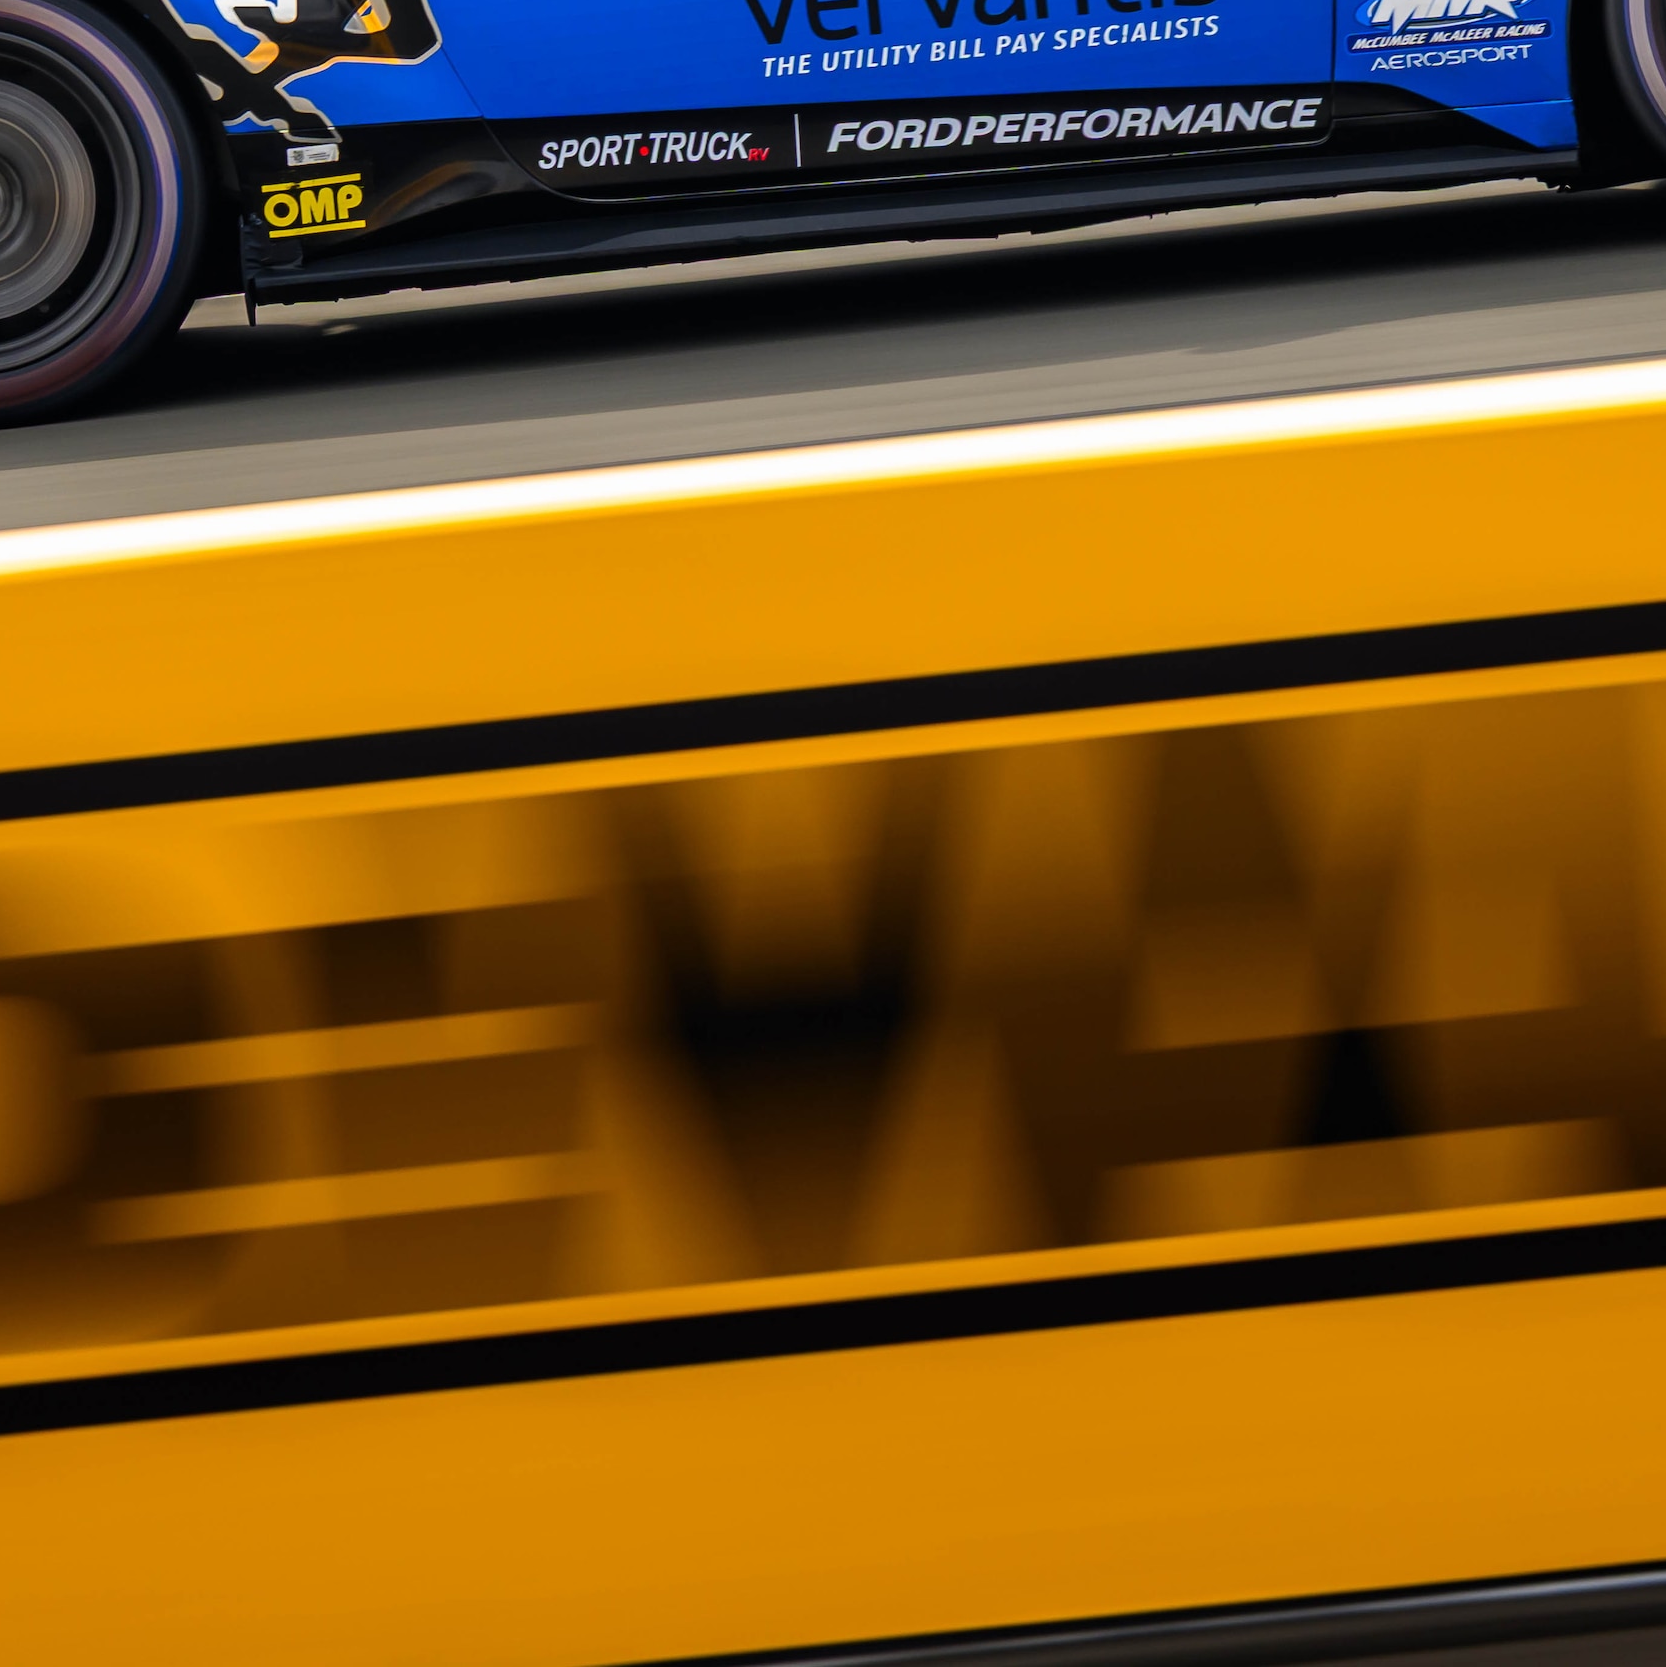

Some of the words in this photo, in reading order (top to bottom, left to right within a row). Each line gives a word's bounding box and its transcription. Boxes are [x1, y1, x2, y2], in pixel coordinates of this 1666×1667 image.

[763, 54, 811, 78] THE
[822, 43, 921, 73] UTILITY
[930, 35, 986, 62] BILL
[995, 31, 1047, 56] PAY
[1053, 14, 1221, 50] SPECIALISTS
[1494, 23, 1547, 38] RACING
[1370, 44, 1533, 71] AEROSPORT
[264, 184, 363, 227] OMP
